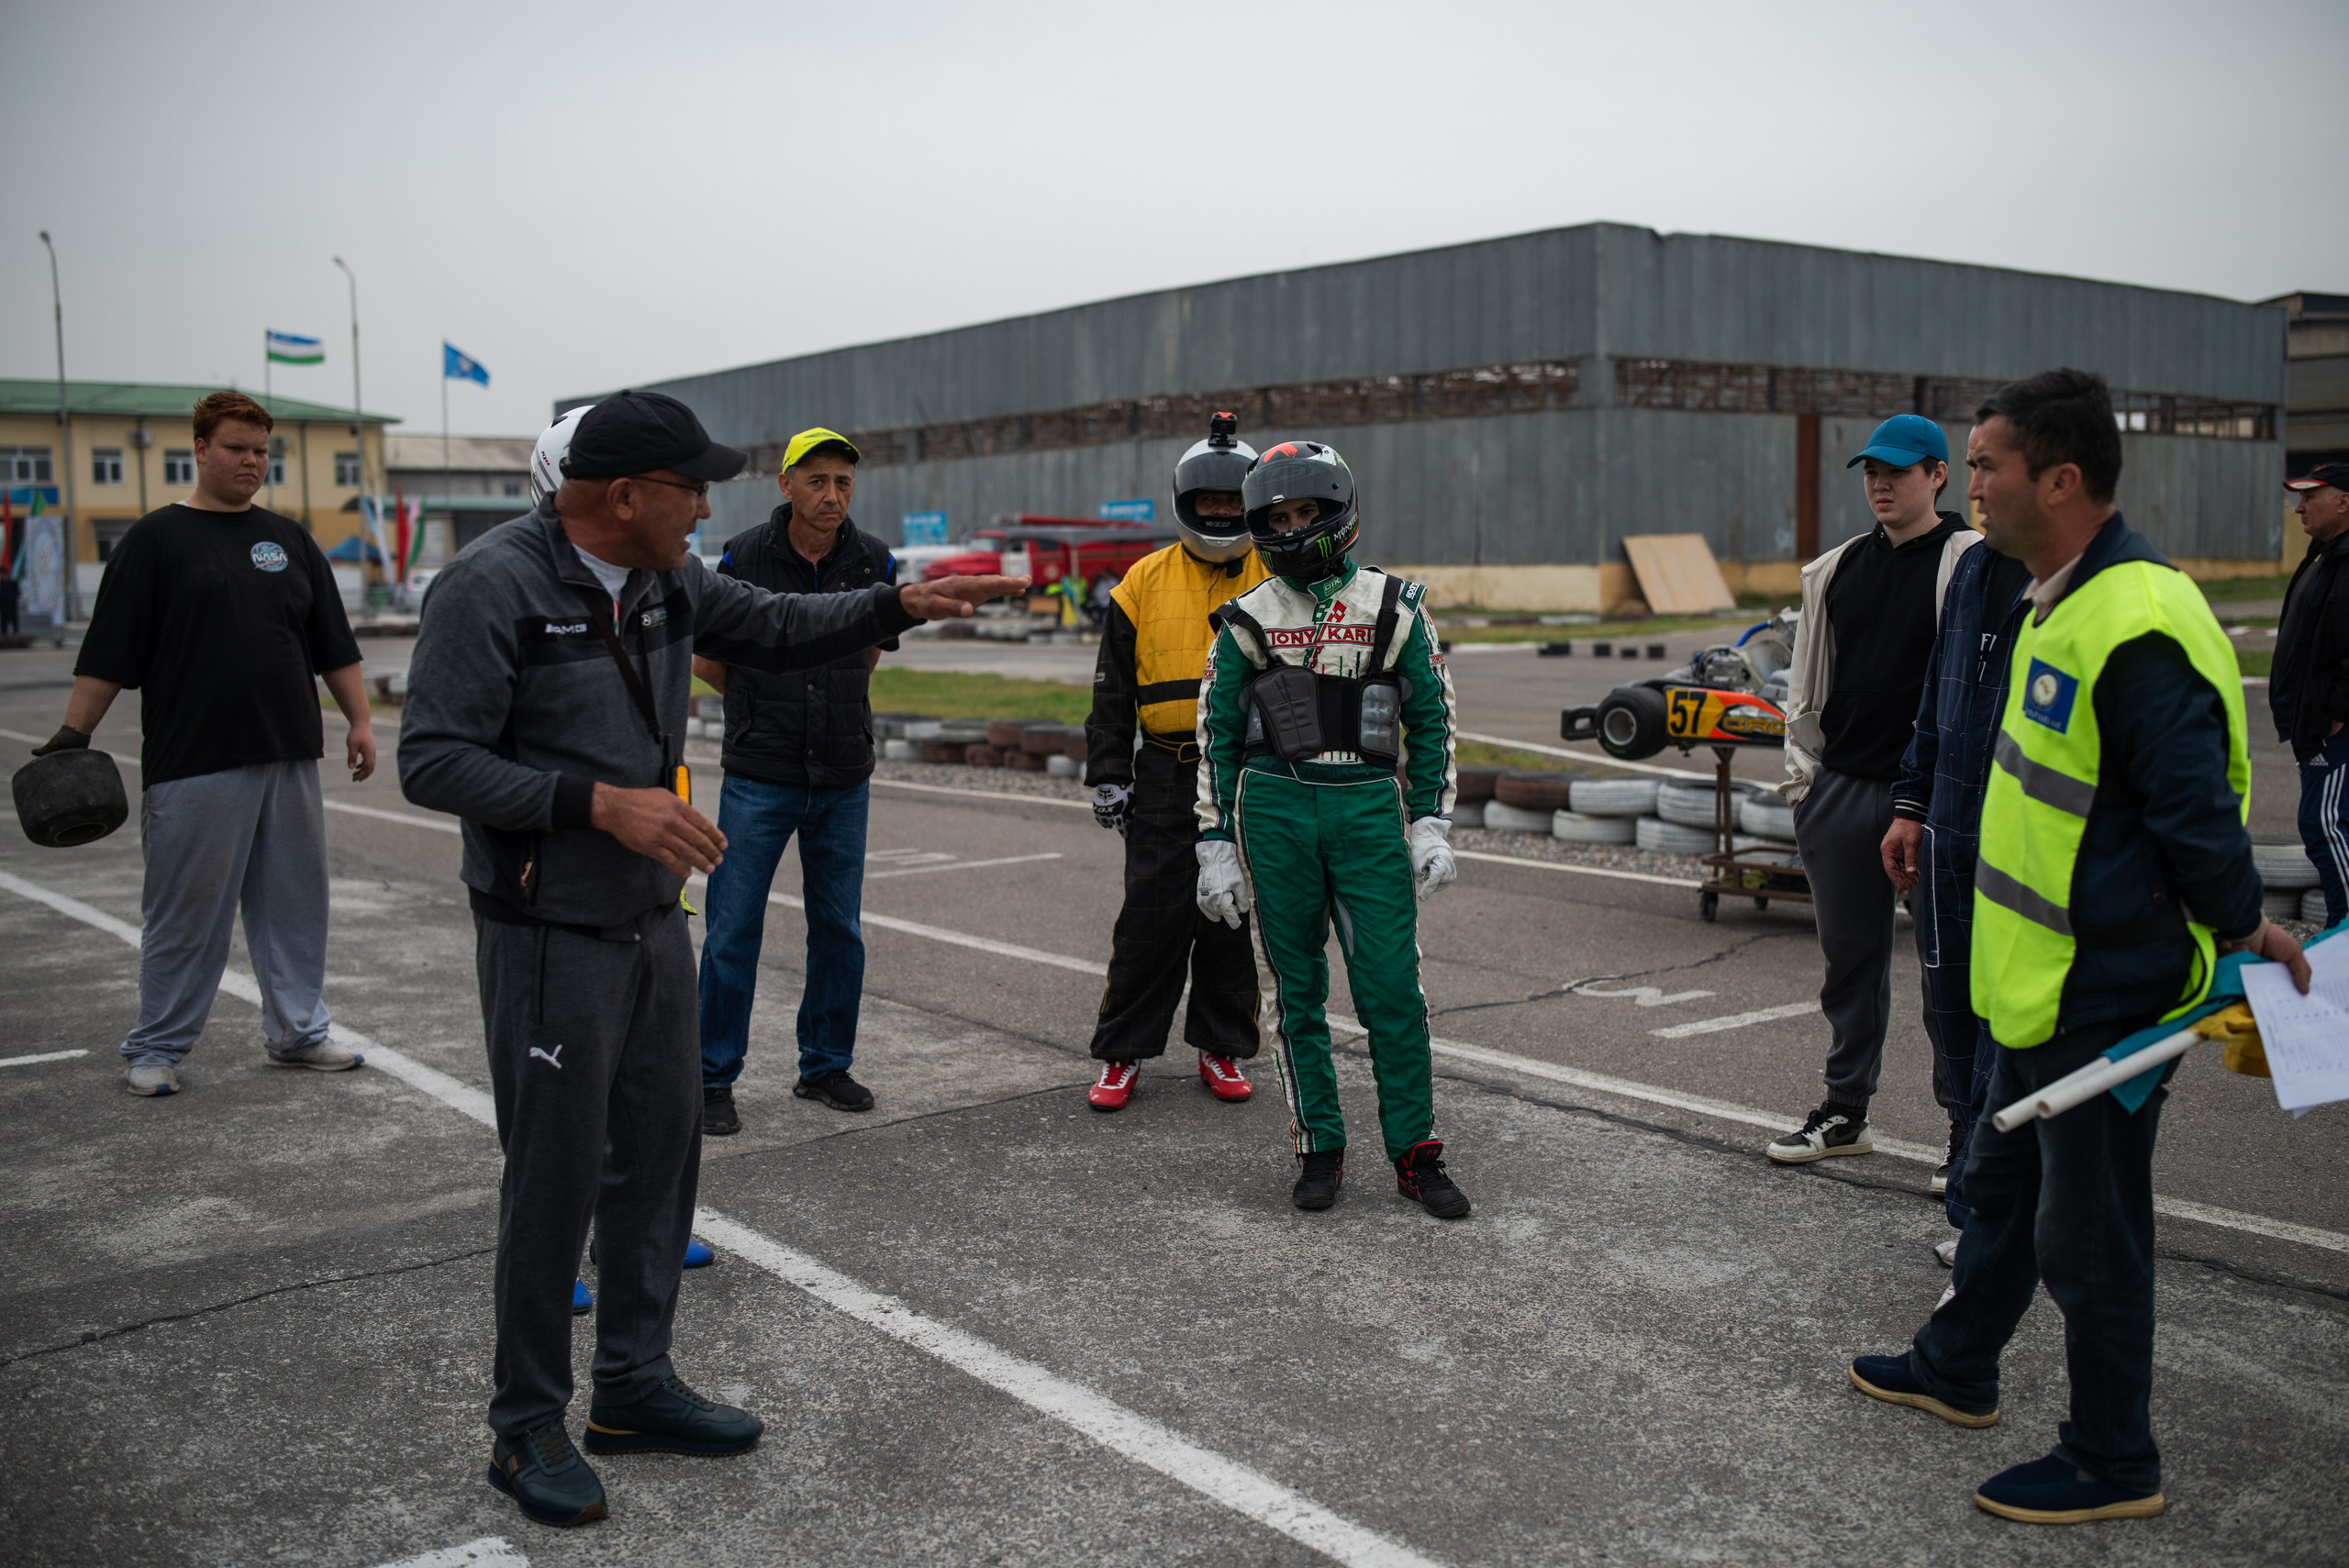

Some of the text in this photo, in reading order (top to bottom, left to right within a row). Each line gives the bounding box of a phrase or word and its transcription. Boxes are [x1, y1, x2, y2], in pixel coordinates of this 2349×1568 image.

[252, 552, 287, 562] NASA
[1324, 577, 1341, 591] OTK
[1266, 627, 1375, 645] TONY KART
[1670, 691, 1707, 735] 57
